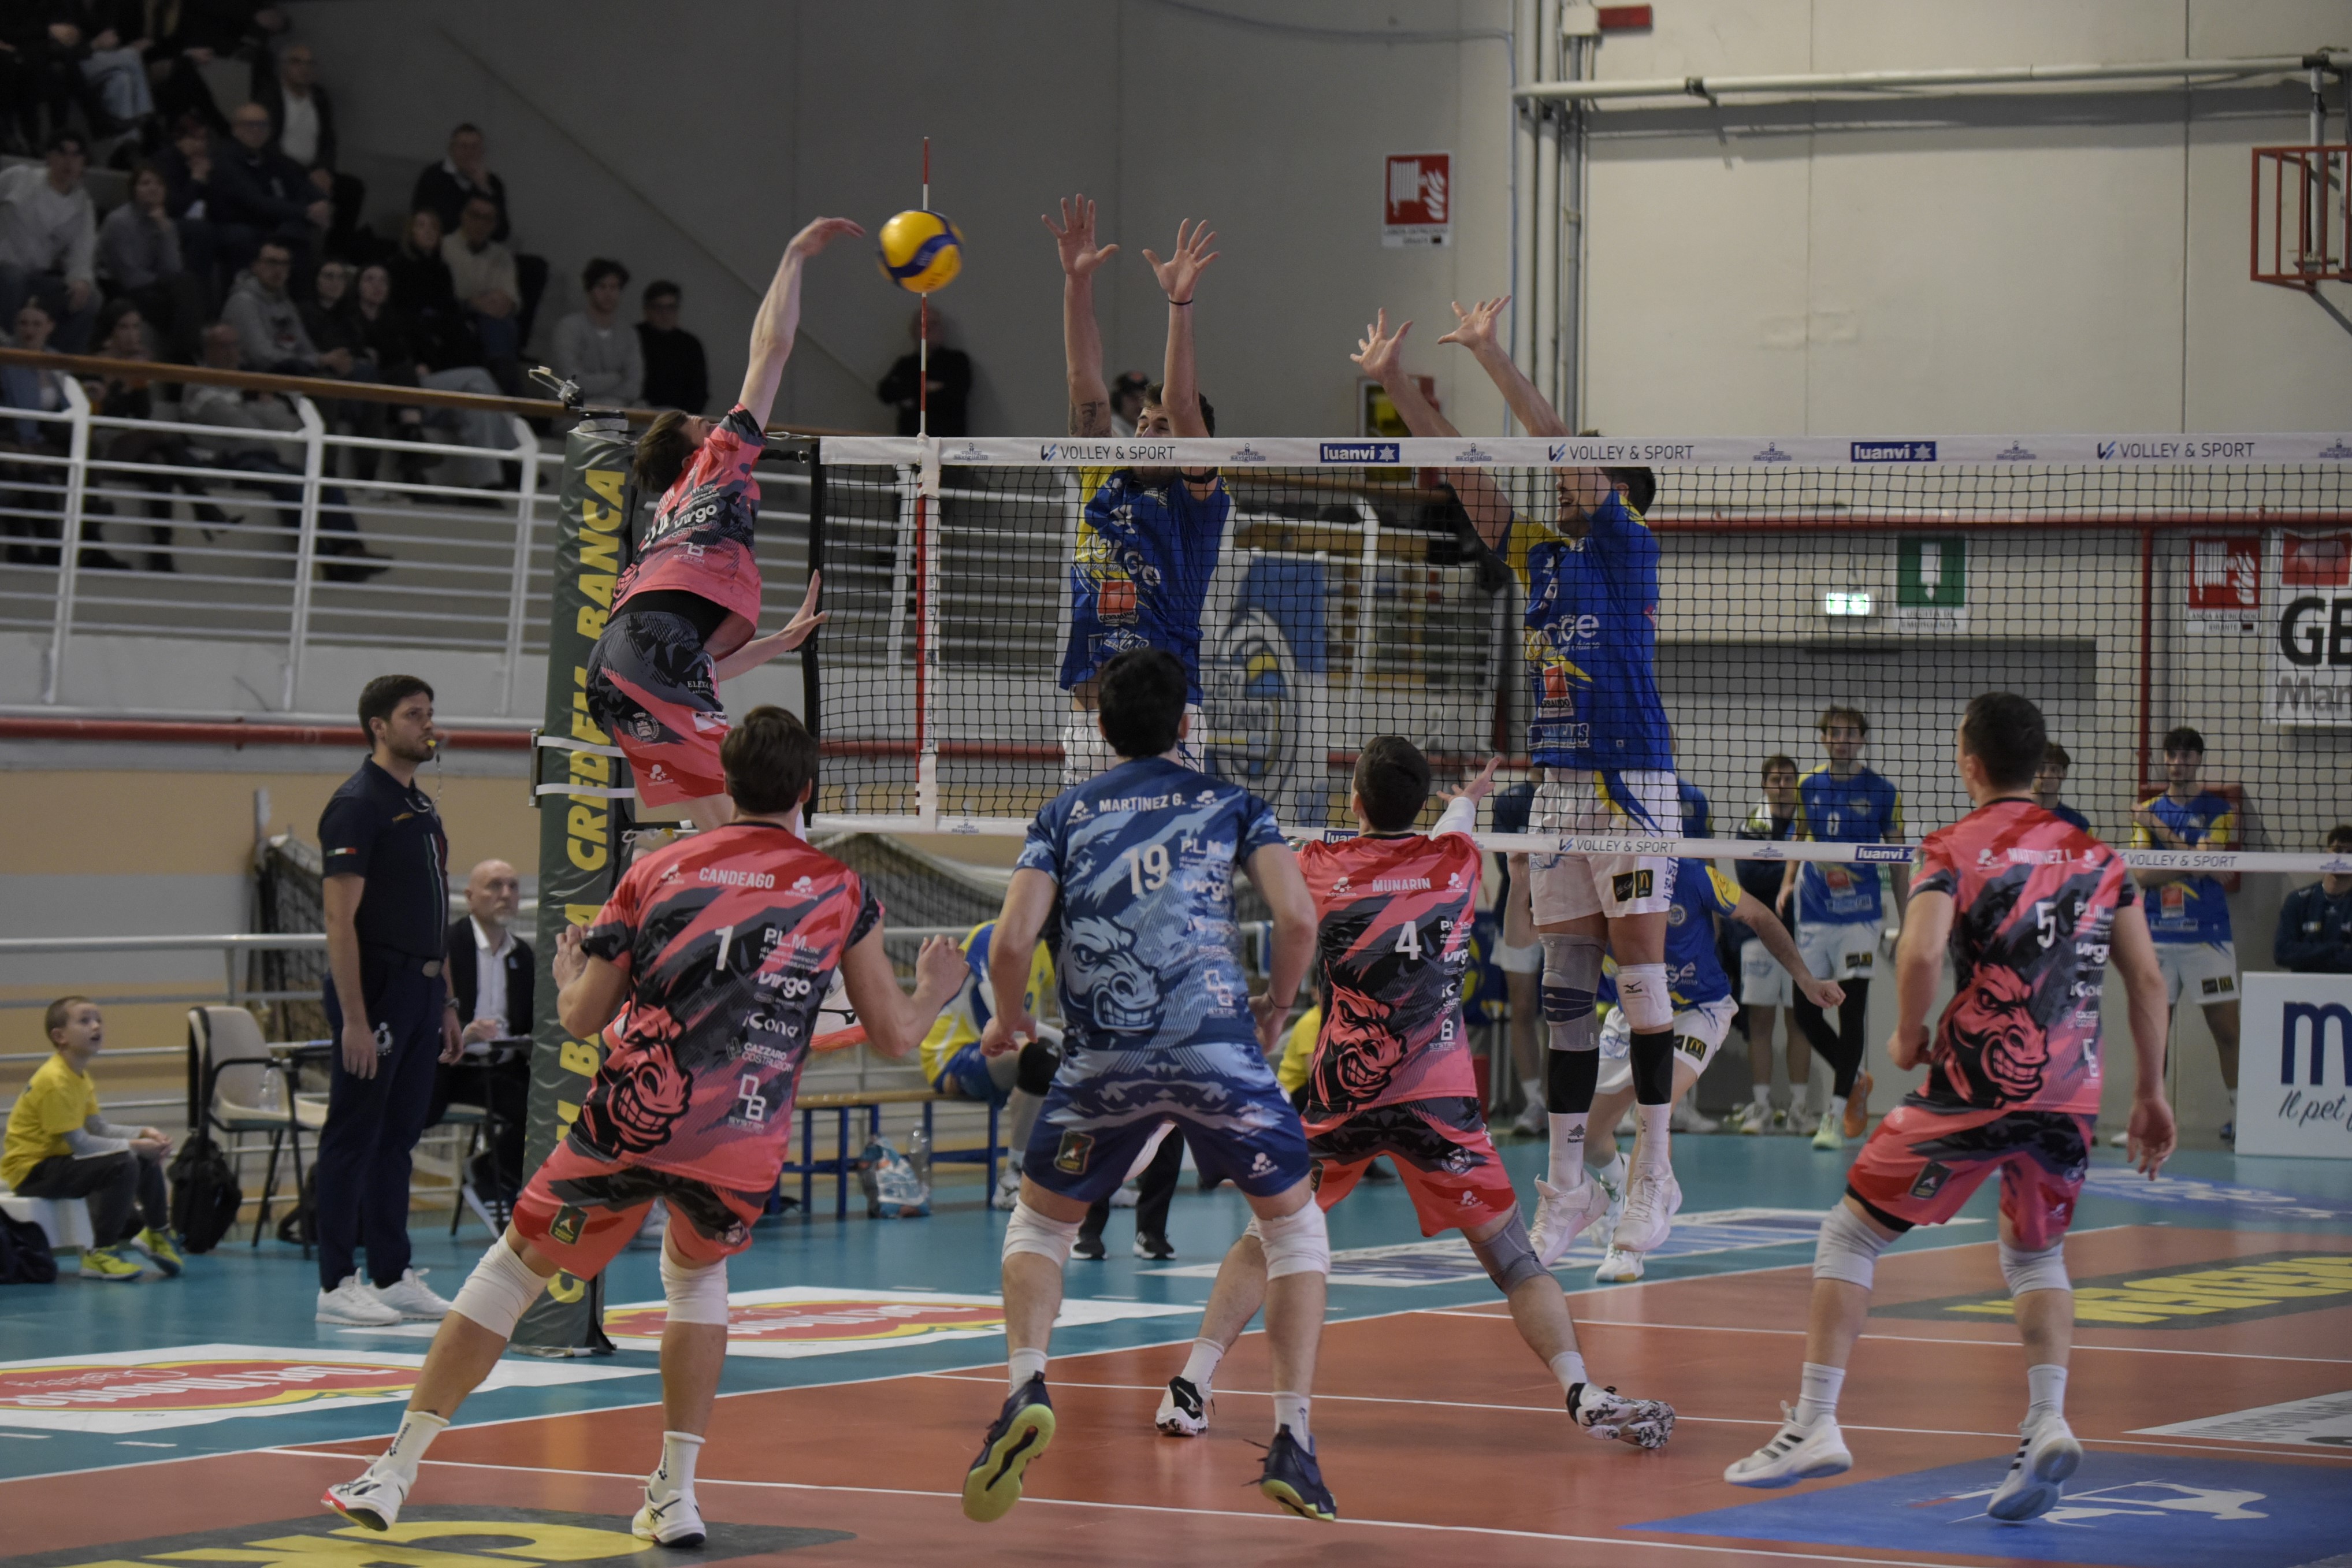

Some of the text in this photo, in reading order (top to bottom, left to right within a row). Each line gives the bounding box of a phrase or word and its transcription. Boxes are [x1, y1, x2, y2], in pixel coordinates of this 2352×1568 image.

[1061, 446, 1176, 460] VOLLEY & SPORT
[1324, 445, 1375, 460] luanvi
[1570, 445, 1694, 460] VOLLEY & SPORT
[1855, 444, 1910, 460] luanvi
[2120, 443, 2255, 458] VOLLEY & SPORT
[577, 469, 626, 638] BANCA
[673, 553, 705, 564] SYSTEM
[1099, 792, 1186, 813] MARTINEZ G.
[1577, 839, 1677, 853] VOLLEY & SPORT
[1857, 848, 1904, 860] luanvi
[2007, 848, 2063, 864] MARTINEZ
[2128, 853, 2238, 868] VOLLEY & SPORT
[1121, 844, 1170, 896] 19
[698, 867, 775, 890] CANDEAGO
[1372, 877, 1432, 893] MUNARIN
[2035, 901, 2056, 949] 5
[714, 925, 734, 972] 1
[1394, 920, 1422, 961] 4
[758, 970, 812, 999] virgo
[743, 1042, 787, 1061] CAZZARO
[2298, 1093, 2347, 1128] pet
